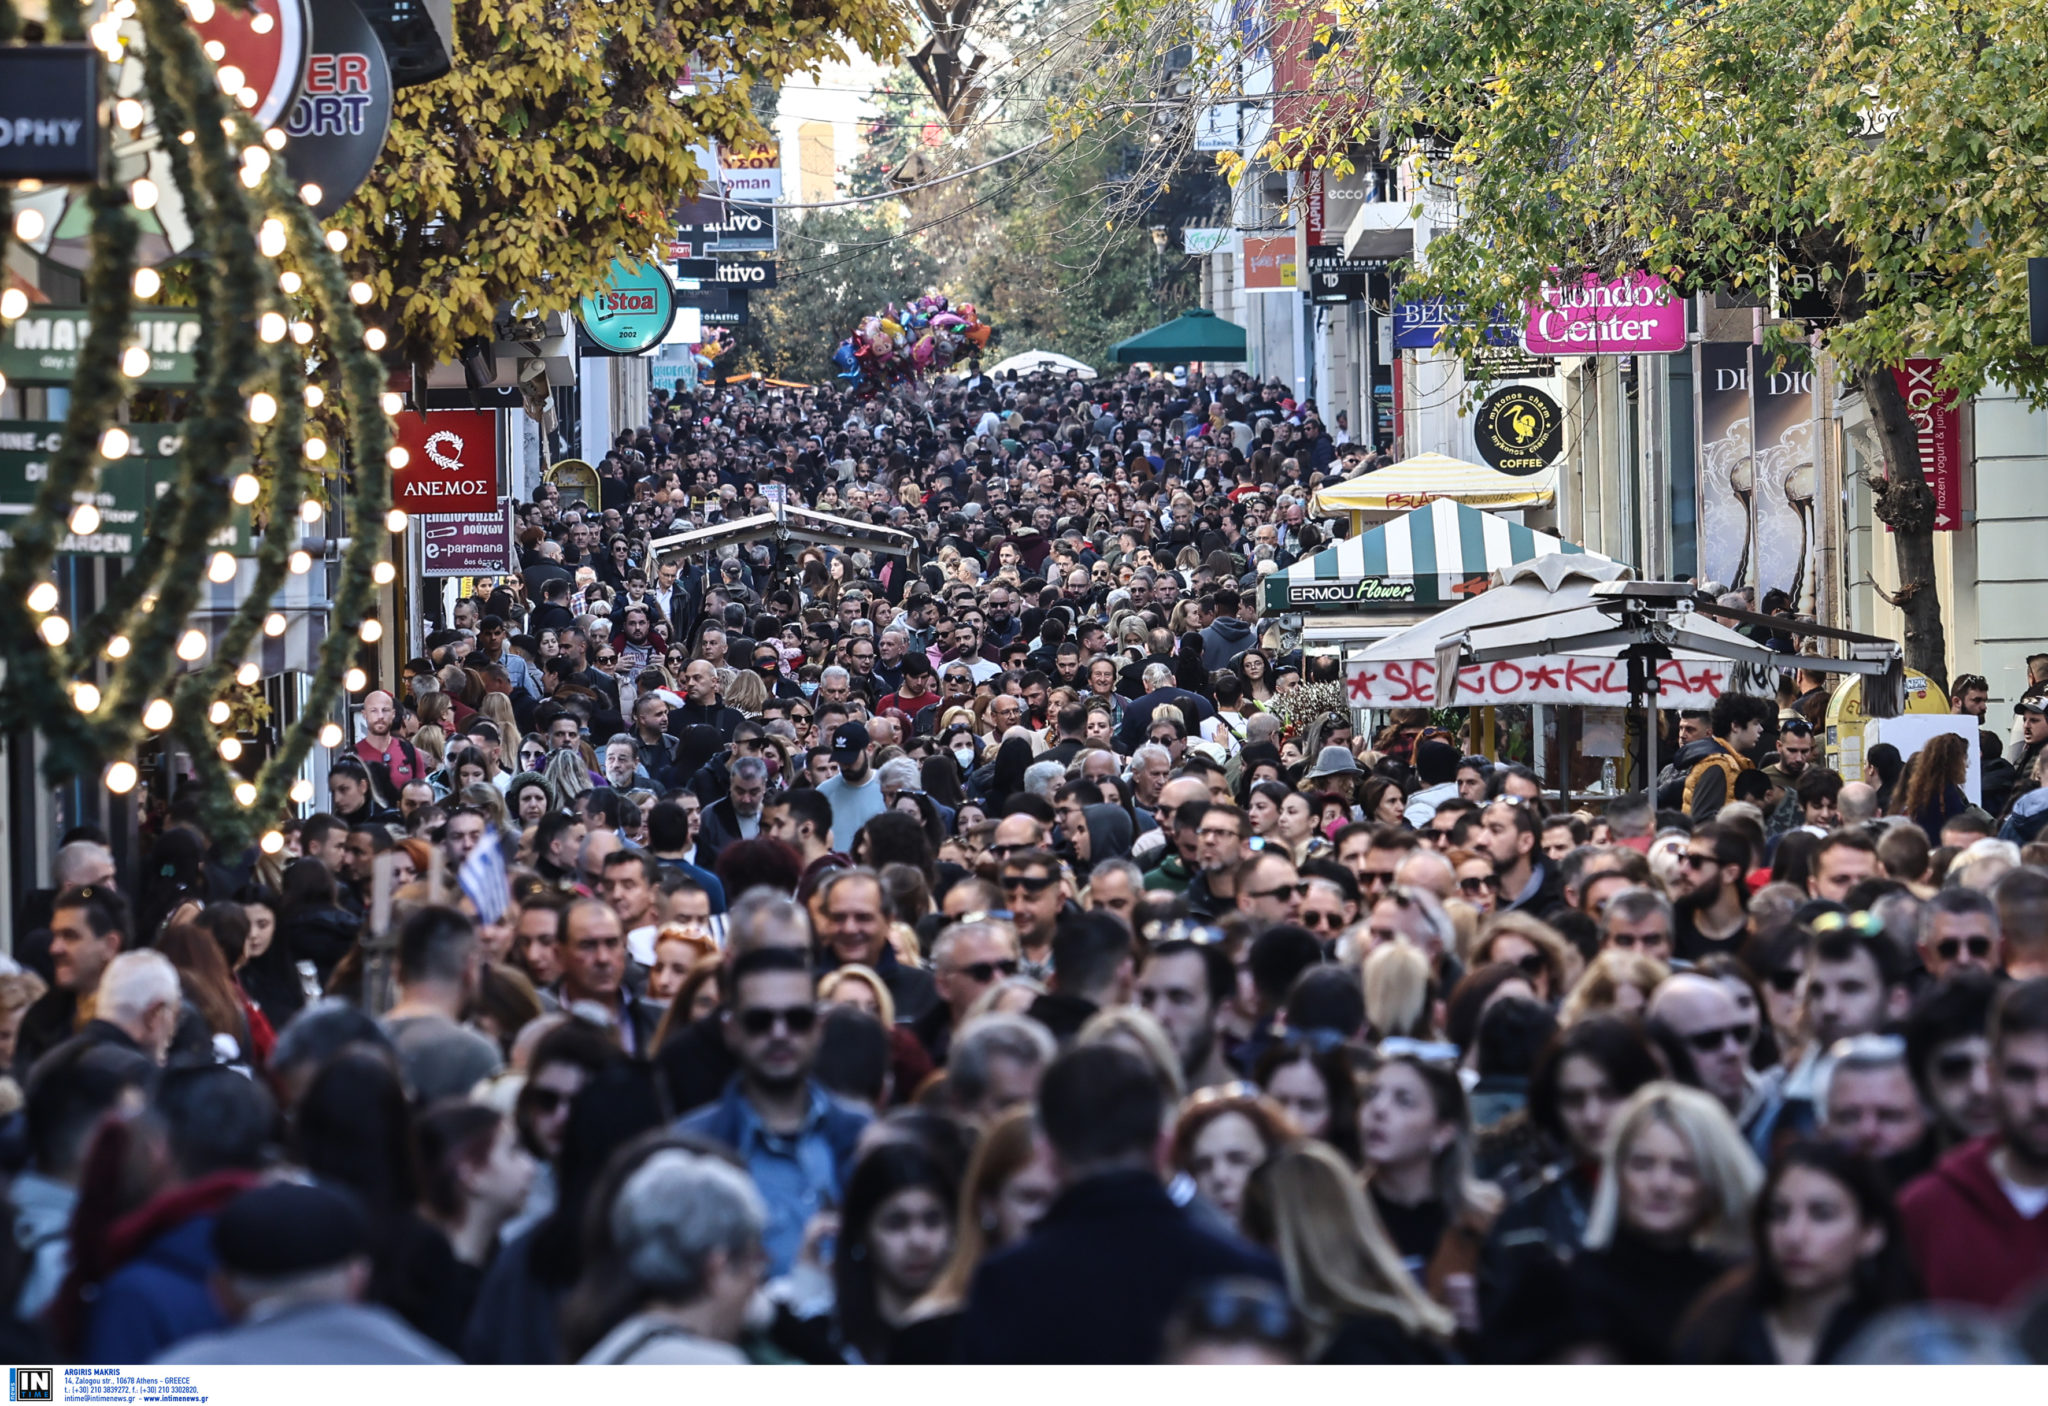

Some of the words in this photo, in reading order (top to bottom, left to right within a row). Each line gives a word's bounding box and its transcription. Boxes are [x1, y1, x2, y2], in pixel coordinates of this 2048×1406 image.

[1328, 190, 1363, 200] ecco
[716, 263, 765, 283] ttivo
[599, 293, 654, 311] iStoa
[1538, 310, 1659, 343] Center
[1528, 395, 1551, 418] charm
[1499, 458, 1542, 468] COFFEE
[1935, 442, 1947, 474] yogurt
[403, 480, 488, 496] ΑΝΕΜΟΣ
[1937, 477, 1947, 510] frozen
[57, 534, 132, 552] ARDEN
[426, 543, 503, 558] e-paramana
[1290, 587, 1354, 600] ERMOU
[1356, 579, 1413, 599] Flower
